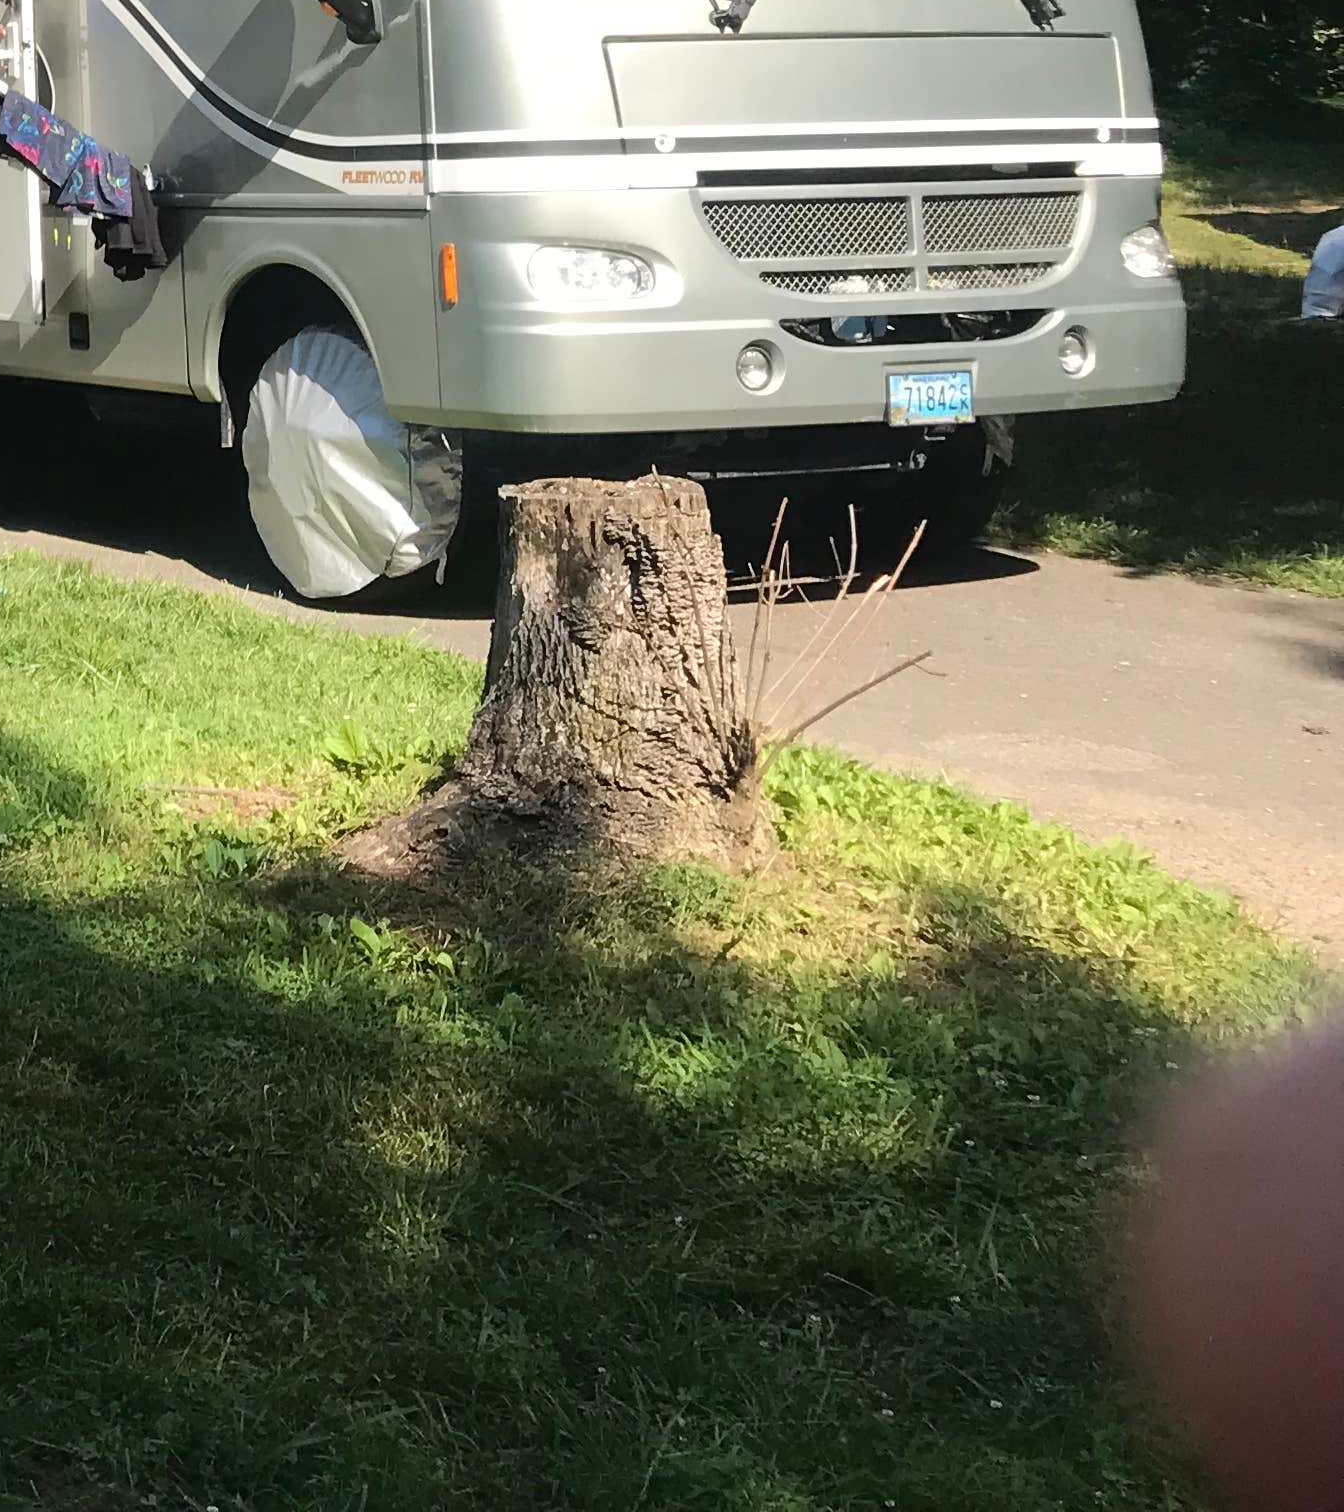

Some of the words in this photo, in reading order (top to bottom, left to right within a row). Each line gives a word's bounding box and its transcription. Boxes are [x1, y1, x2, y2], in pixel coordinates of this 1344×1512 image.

[342, 170, 407, 184] FLEETWOOD
[409, 170, 425, 184] RV
[904, 384, 958, 412] 71842
